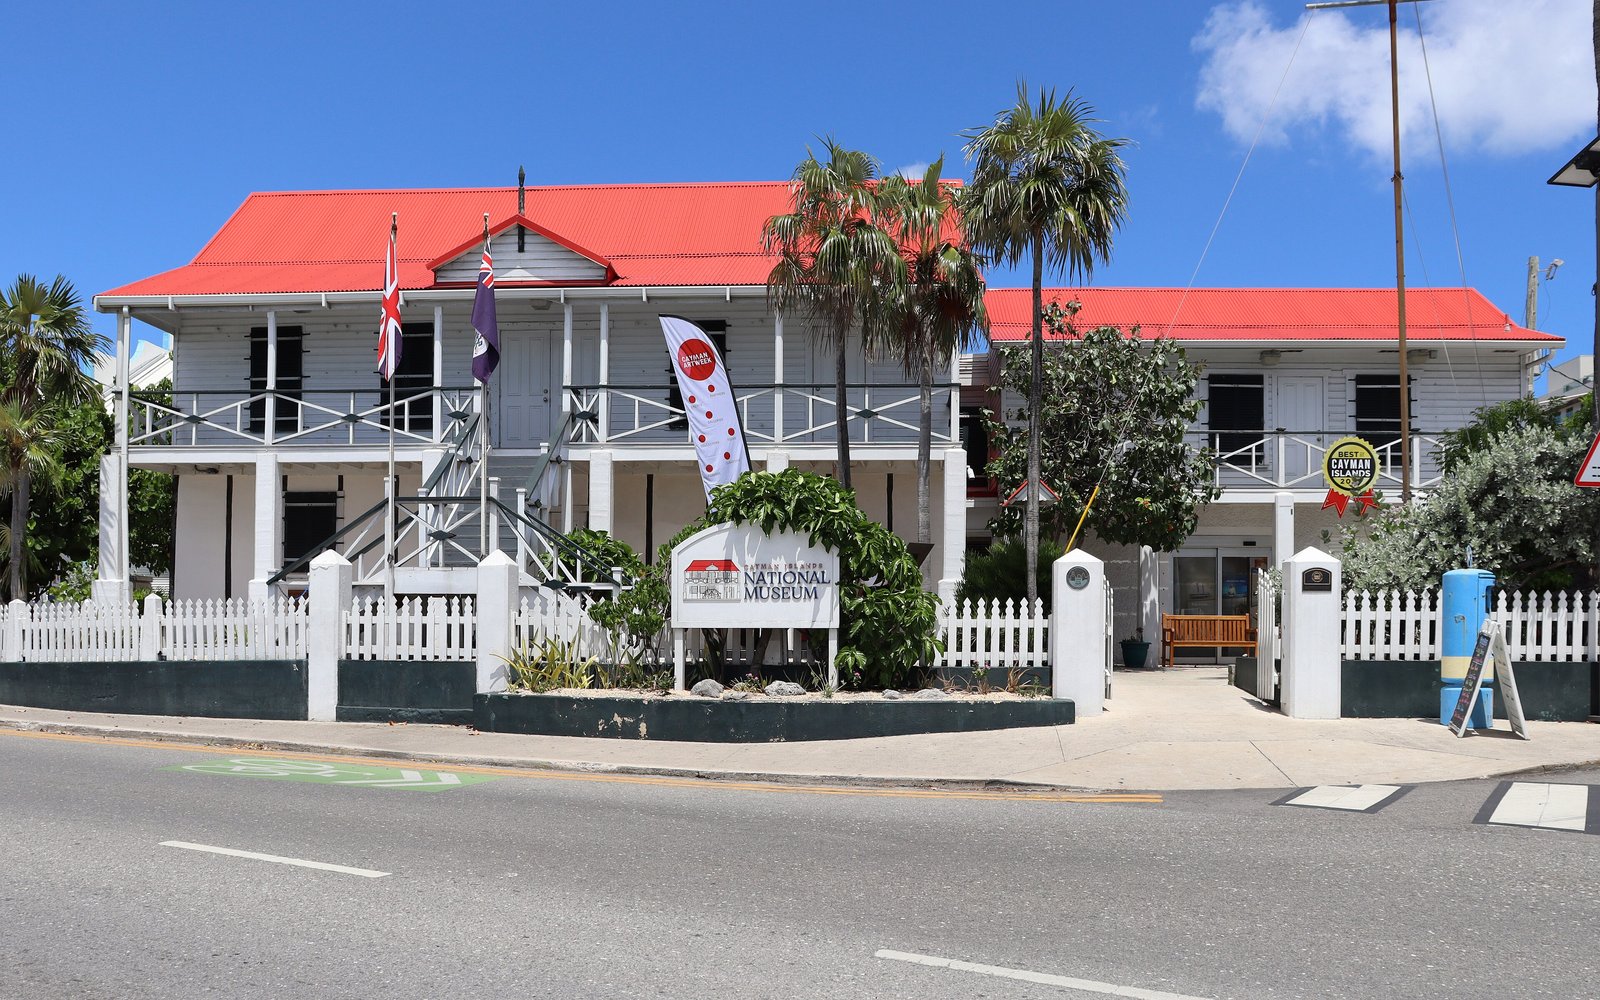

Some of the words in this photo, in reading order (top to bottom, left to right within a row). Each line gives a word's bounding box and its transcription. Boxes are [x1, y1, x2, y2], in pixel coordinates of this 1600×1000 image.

[681, 352, 708, 363] CAYMAN
[683, 357, 712, 368] ARTWEEK
[1331, 458, 1371, 469] CAYMAN
[1331, 469, 1371, 477] ISLANDS
[744, 563, 779, 571] CAYMAN
[744, 571, 831, 585] NATIONAL
[744, 586, 818, 600] MUSEUM
